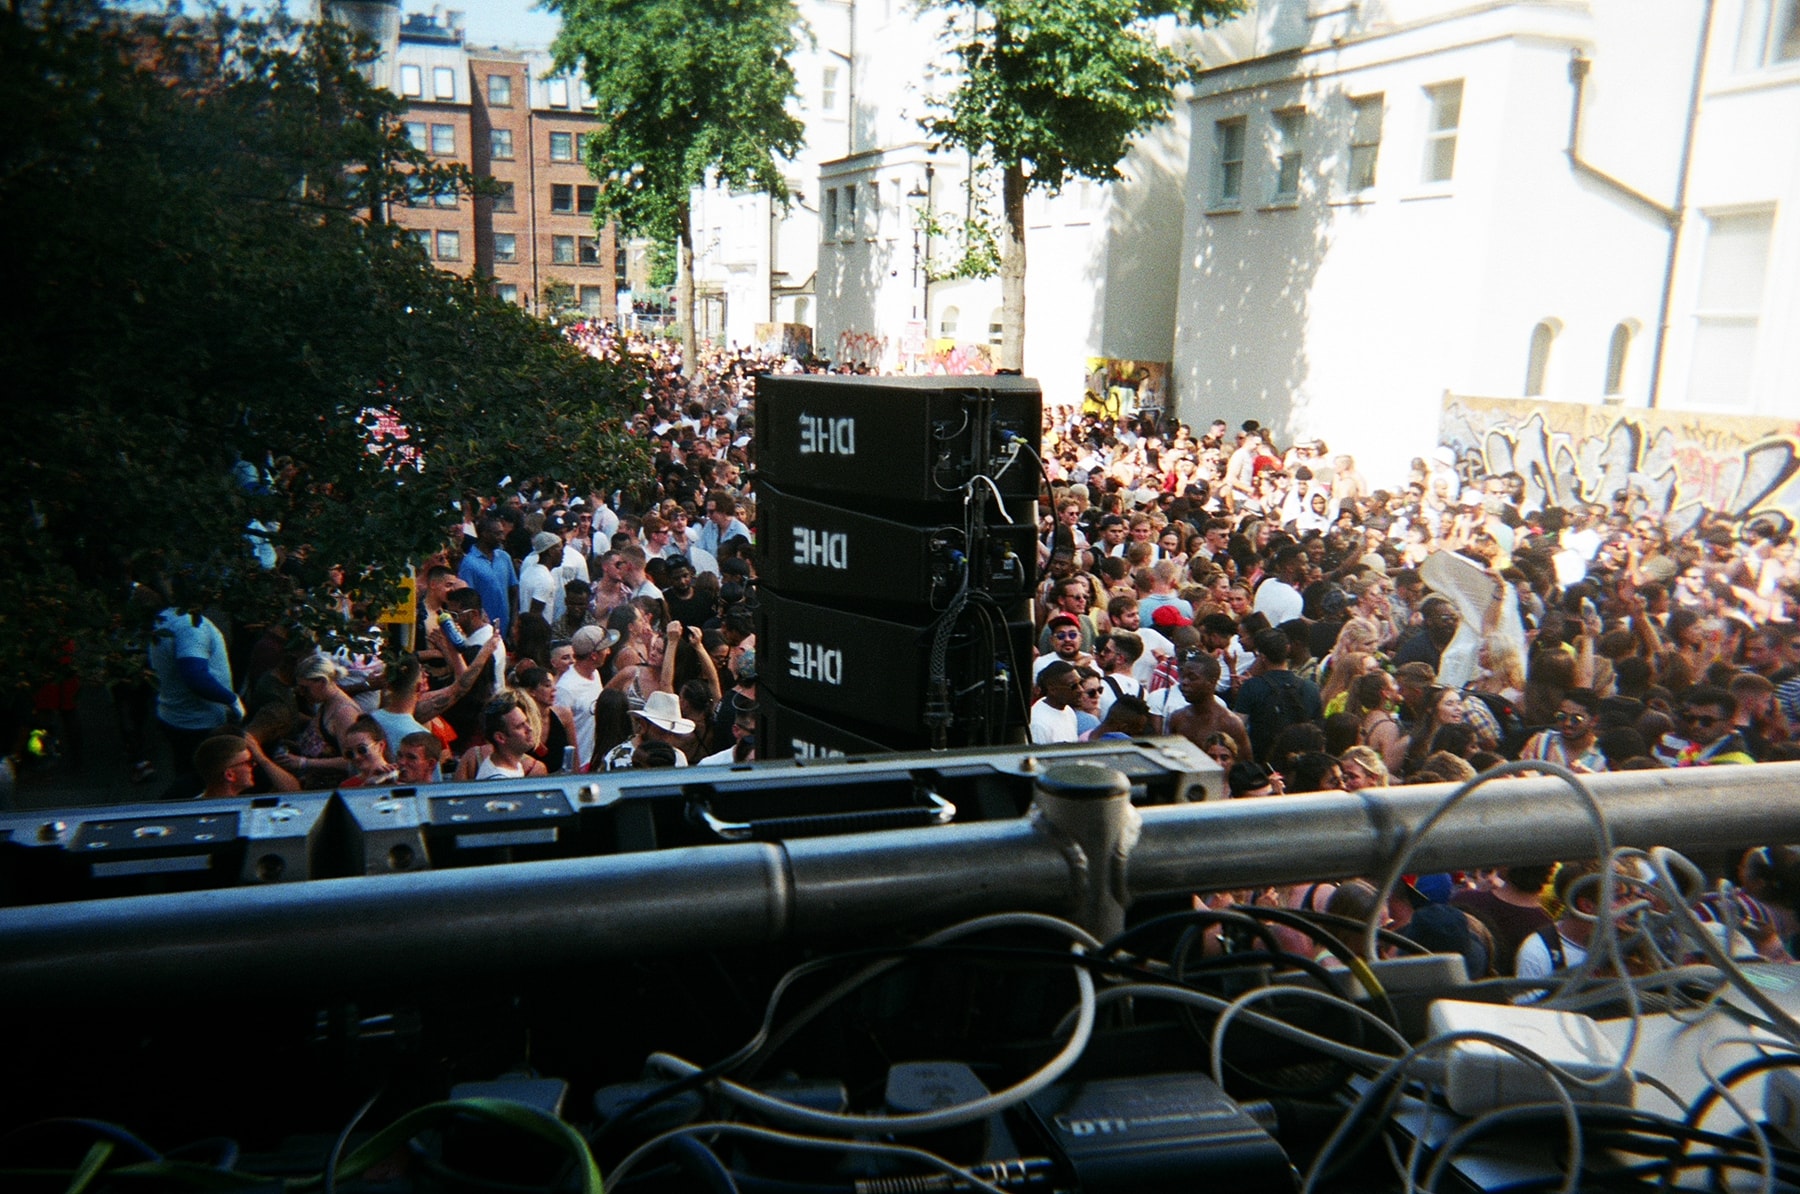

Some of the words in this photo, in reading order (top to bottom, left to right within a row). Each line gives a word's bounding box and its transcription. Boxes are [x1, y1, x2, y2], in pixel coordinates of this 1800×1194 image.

[799, 413, 855, 455] DHE
[793, 526, 847, 569] DHE
[789, 641, 842, 685] DHE
